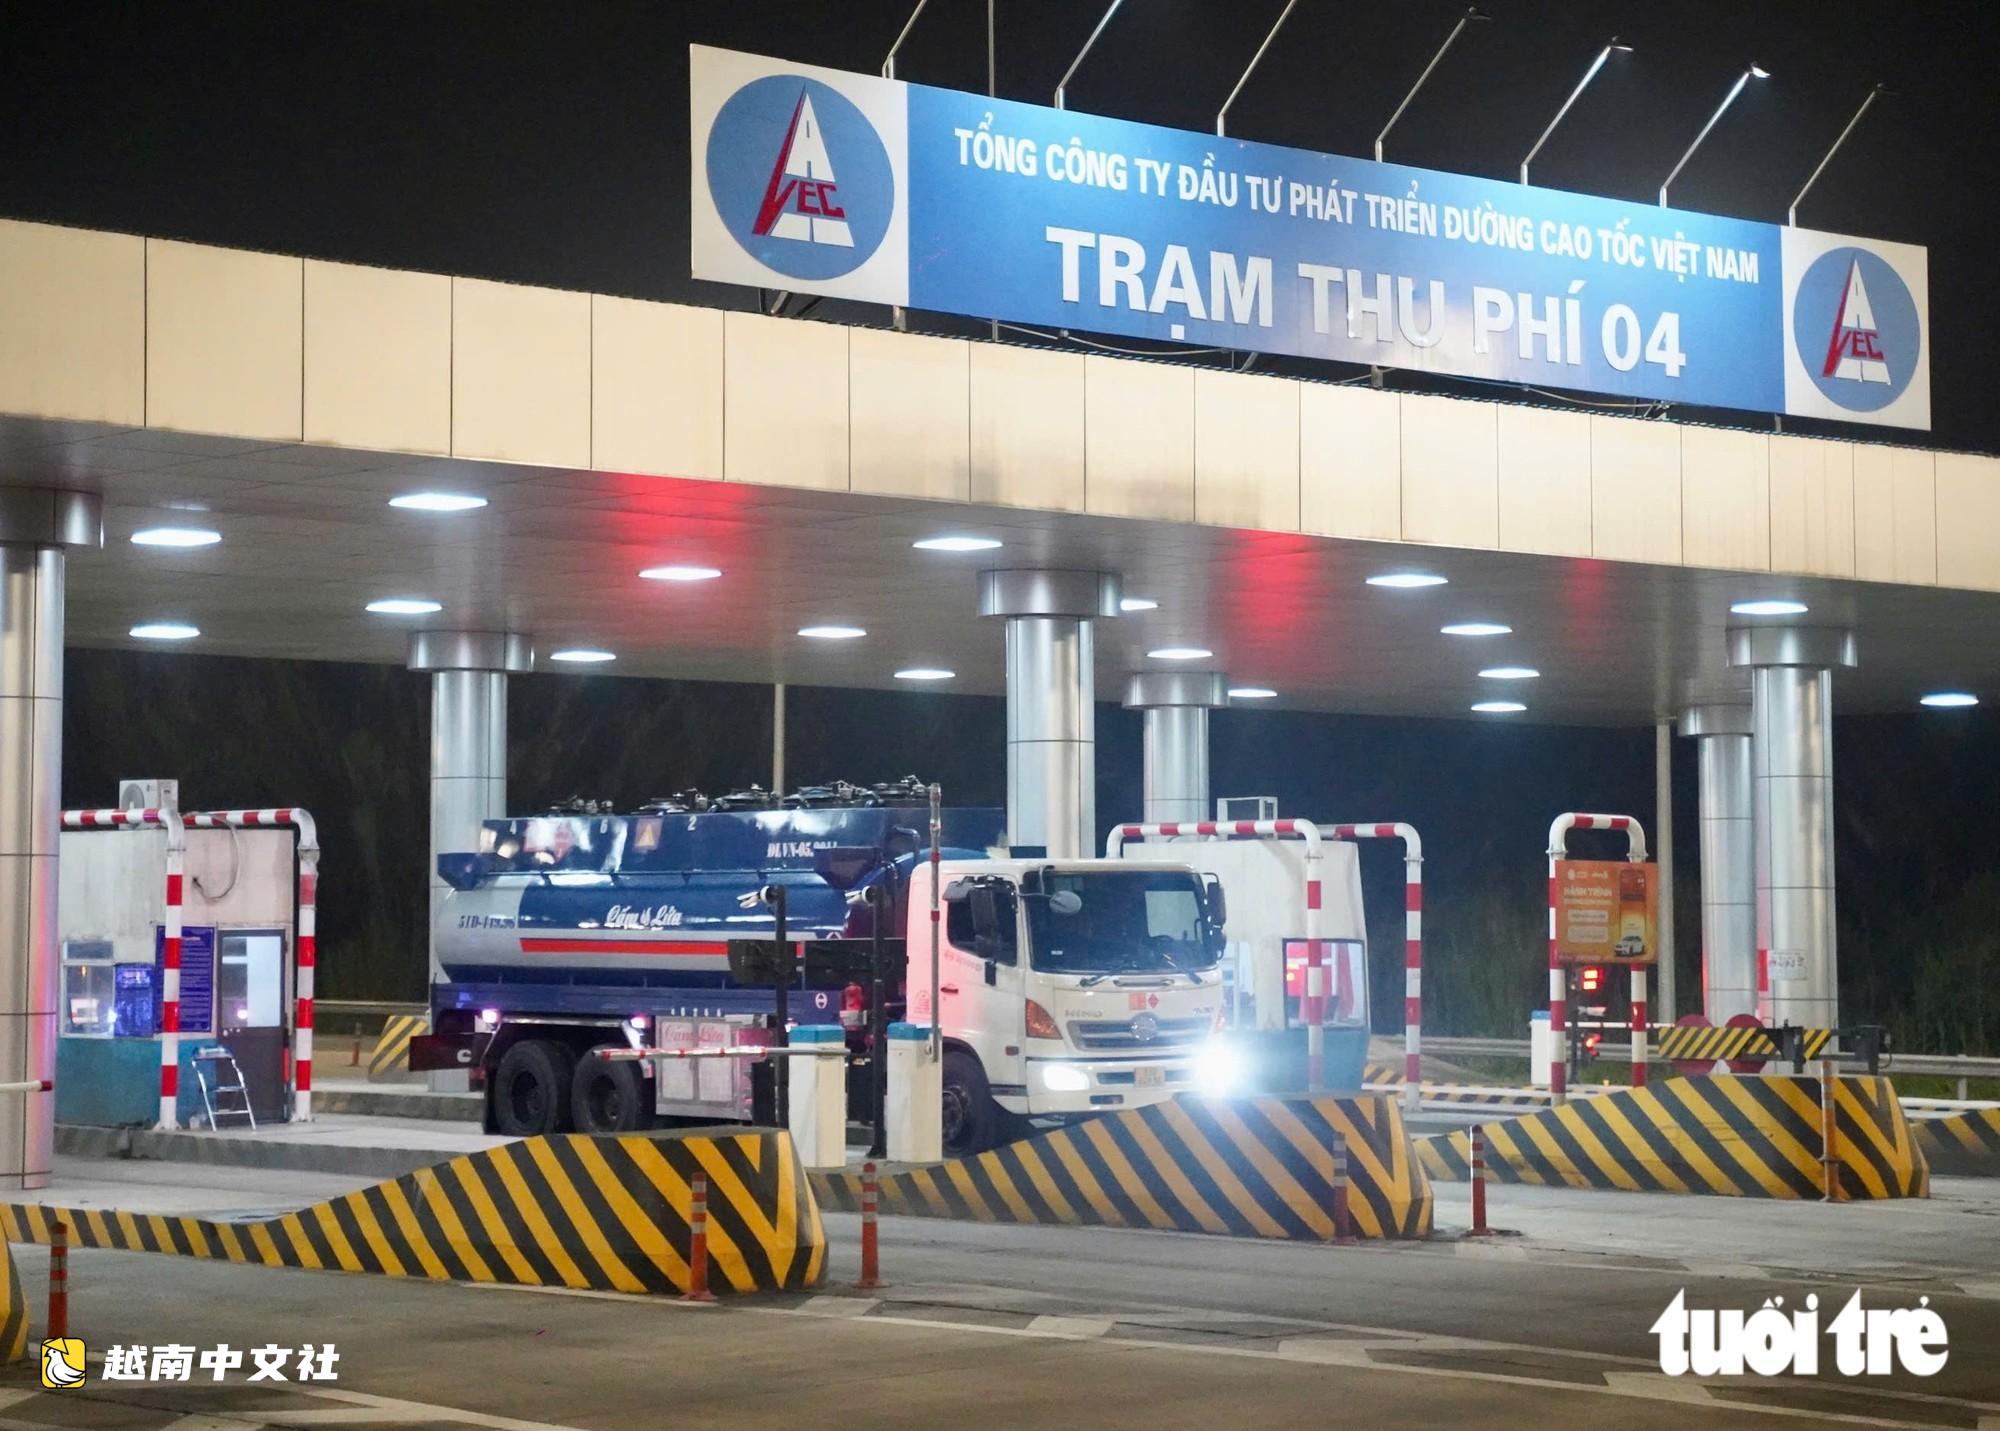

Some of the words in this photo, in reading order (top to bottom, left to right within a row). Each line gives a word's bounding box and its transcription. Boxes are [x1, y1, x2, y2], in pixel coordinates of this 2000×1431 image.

[954, 111, 1037, 177] TỔNG
[1045, 136, 1128, 191] CÔNG
[1134, 157, 1171, 197] TY
[1178, 151, 1239, 208] ĐẦU
[1245, 171, 1283, 214] TƯ
[1290, 178, 1358, 225] PHÁT
[1364, 179, 1437, 238] TRIỂN
[1443, 201, 1535, 252] ĐƯỜNG
[1540, 220, 1593, 261] CAO
[1597, 217, 1646, 269] TỐC
[1650, 230, 1701, 284] VIỆT
[1706, 245, 1760, 284] NAM
[1046, 225, 1274, 341] TRẠM
[1298, 262, 1446, 348] THU
[1473, 279, 1588, 366] PHÍ
[1601, 303, 1688, 378] 04
[687, 815, 698, 832] 2
